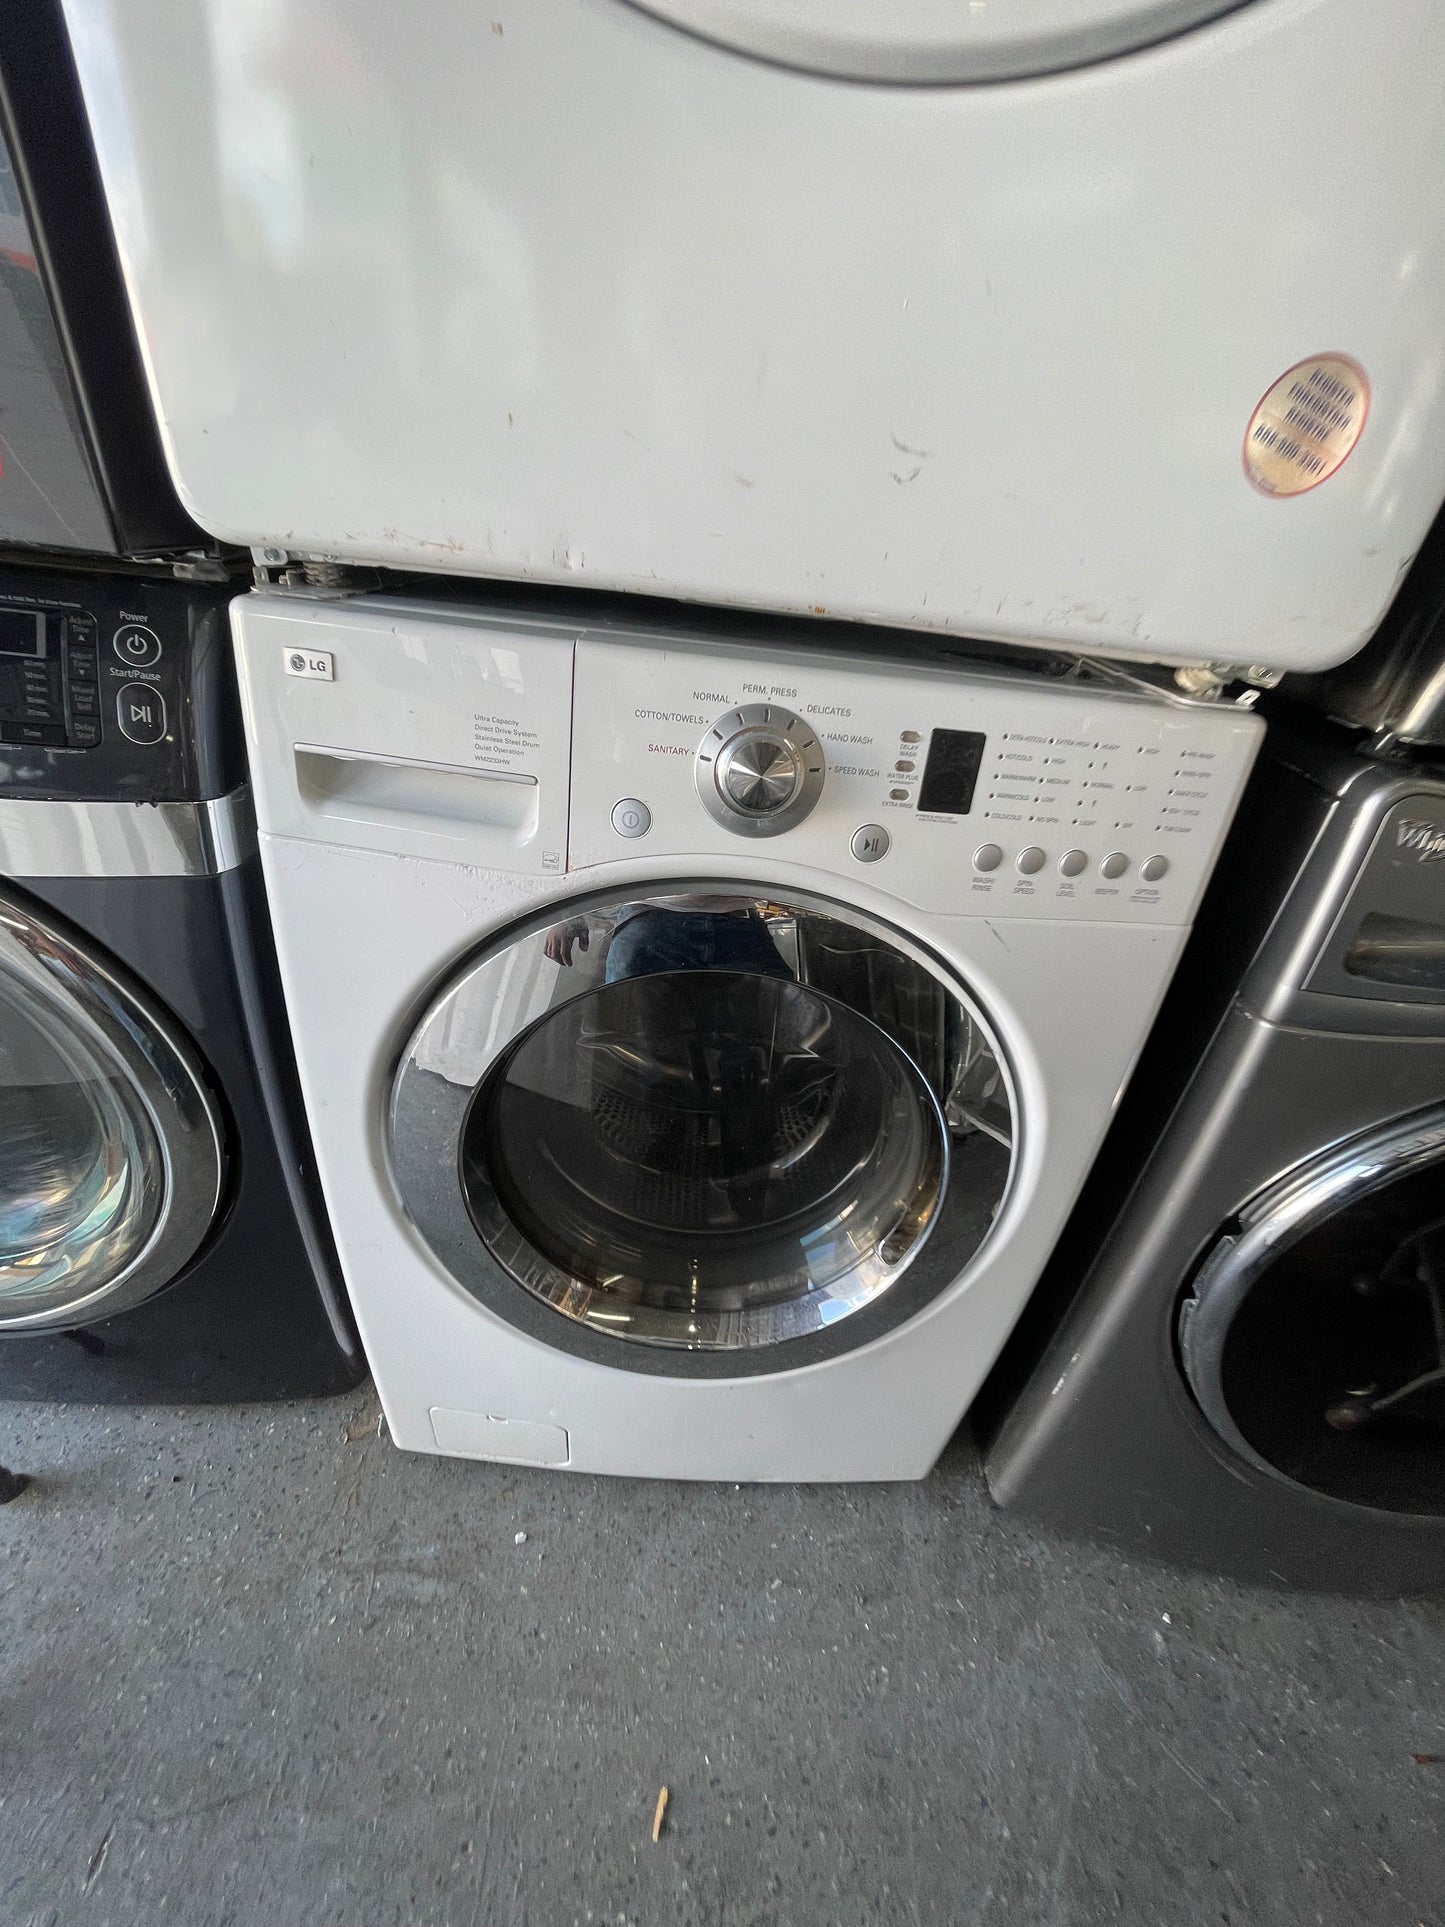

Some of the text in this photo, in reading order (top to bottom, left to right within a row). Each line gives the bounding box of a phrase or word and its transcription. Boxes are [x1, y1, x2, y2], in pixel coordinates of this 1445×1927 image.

[119, 610, 149, 623] Power
[309, 659, 326, 672] LG
[109, 666, 162, 681] Start/Pause
[742, 683, 798, 698] PERM. PRESS
[692, 691, 731, 704] NORMAL
[634, 709, 704, 725] COTTON/TOWELS
[807, 704, 852, 717] DELICATES
[474, 714, 520, 726] Ultra Capacity
[474, 723, 538, 738] Direct Drive System
[474, 733, 541, 749] Stainless Steel Drum
[827, 733, 873, 745] HAND WASH
[474, 743, 525, 756] Quiet Operation
[648, 743, 690, 756] SANITARY
[834, 766, 880, 777] SPEED WASH
